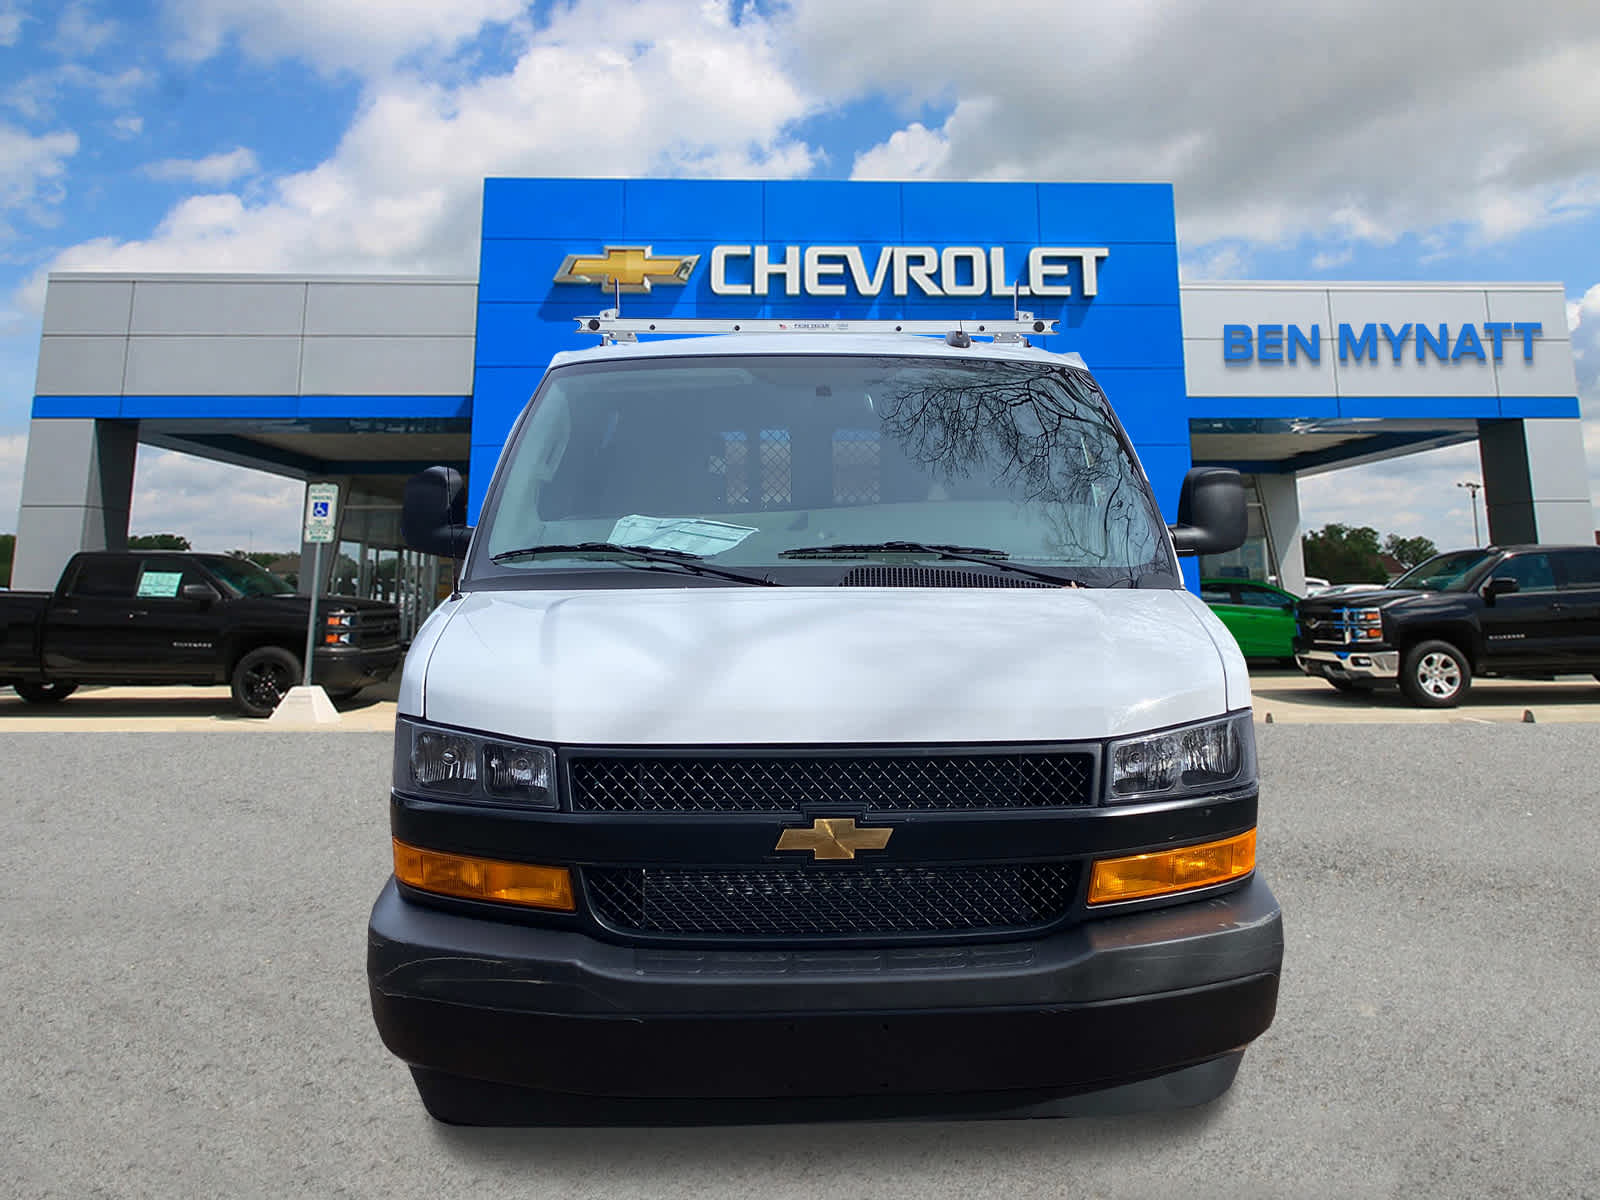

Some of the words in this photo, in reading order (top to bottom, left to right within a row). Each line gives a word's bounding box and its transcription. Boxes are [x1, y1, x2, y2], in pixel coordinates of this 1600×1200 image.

[710, 245, 1110, 297] CHEVROLET
[1223, 323, 1321, 365] BEN
[1338, 322, 1543, 365] MYNATT
